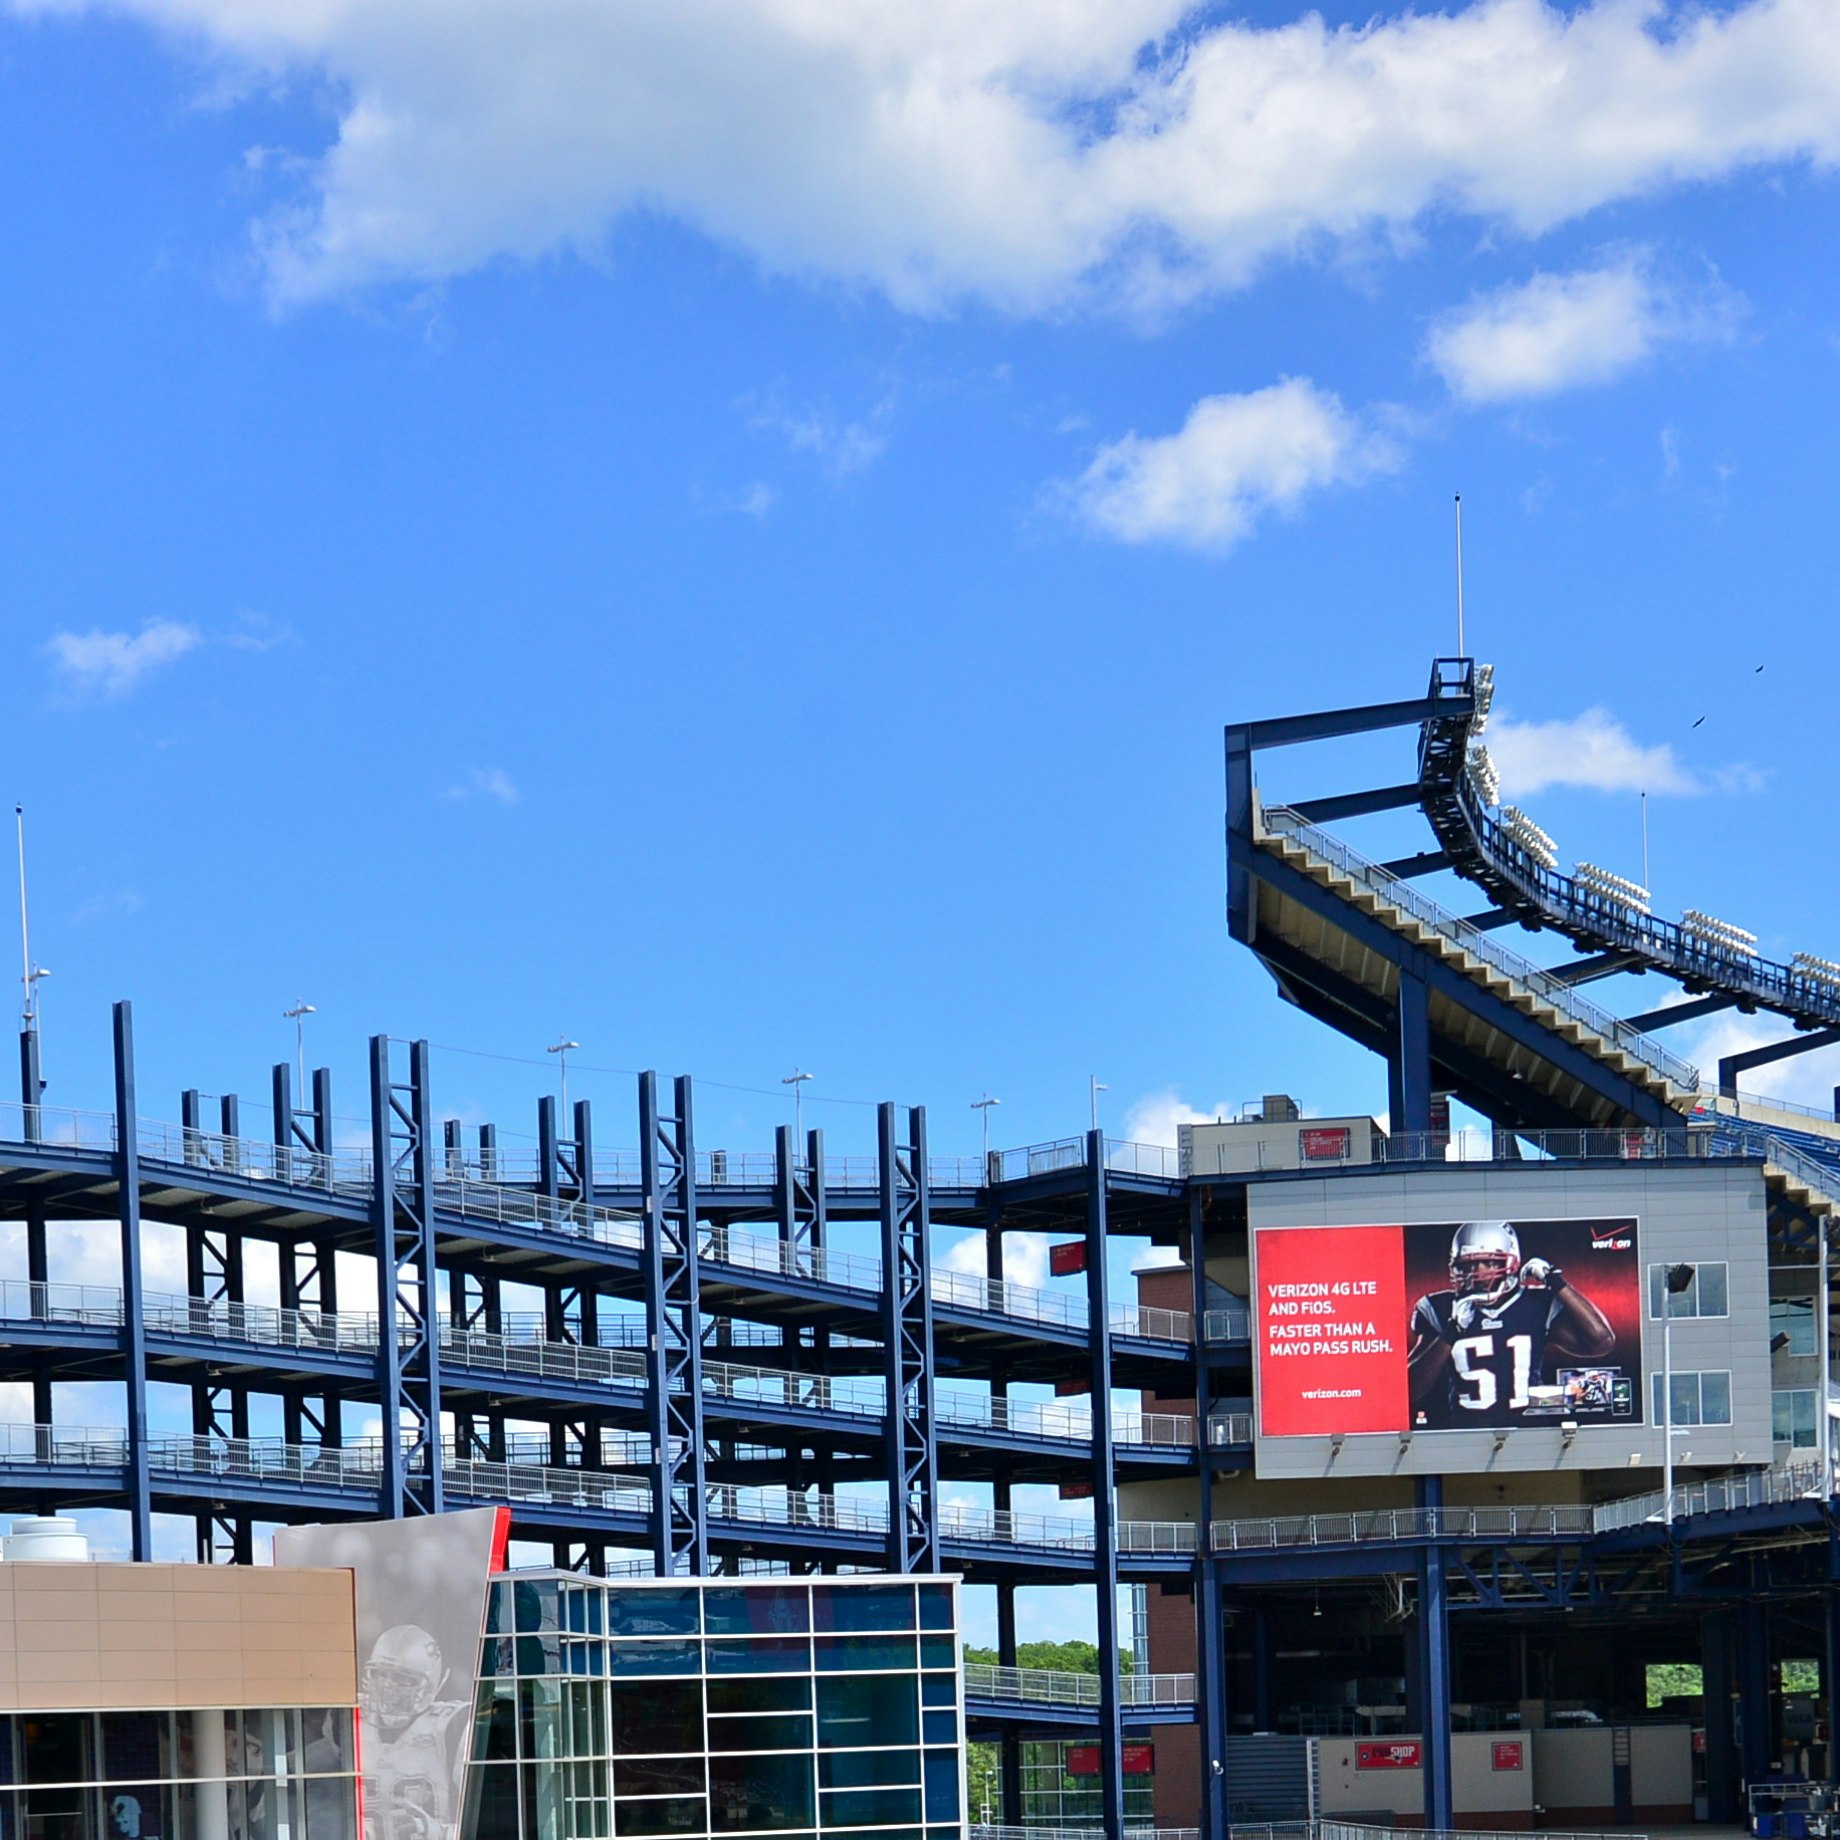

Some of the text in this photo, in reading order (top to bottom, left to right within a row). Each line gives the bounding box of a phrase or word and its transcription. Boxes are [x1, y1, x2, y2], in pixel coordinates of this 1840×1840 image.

[1592, 1238, 1631, 1249] verizon
[1268, 1281, 1377, 1298] VERIZON 4G LTE
[1269, 1301, 1336, 1316] AND FiOS.
[1269, 1322, 1376, 1338] FASTER THAN A
[1270, 1340, 1393, 1356] MAYO PASS RUSH.
[1451, 1335, 1532, 1410] 51
[1302, 1389, 1362, 1399] verizon.com
[1390, 1745, 1415, 1758] SHOP
